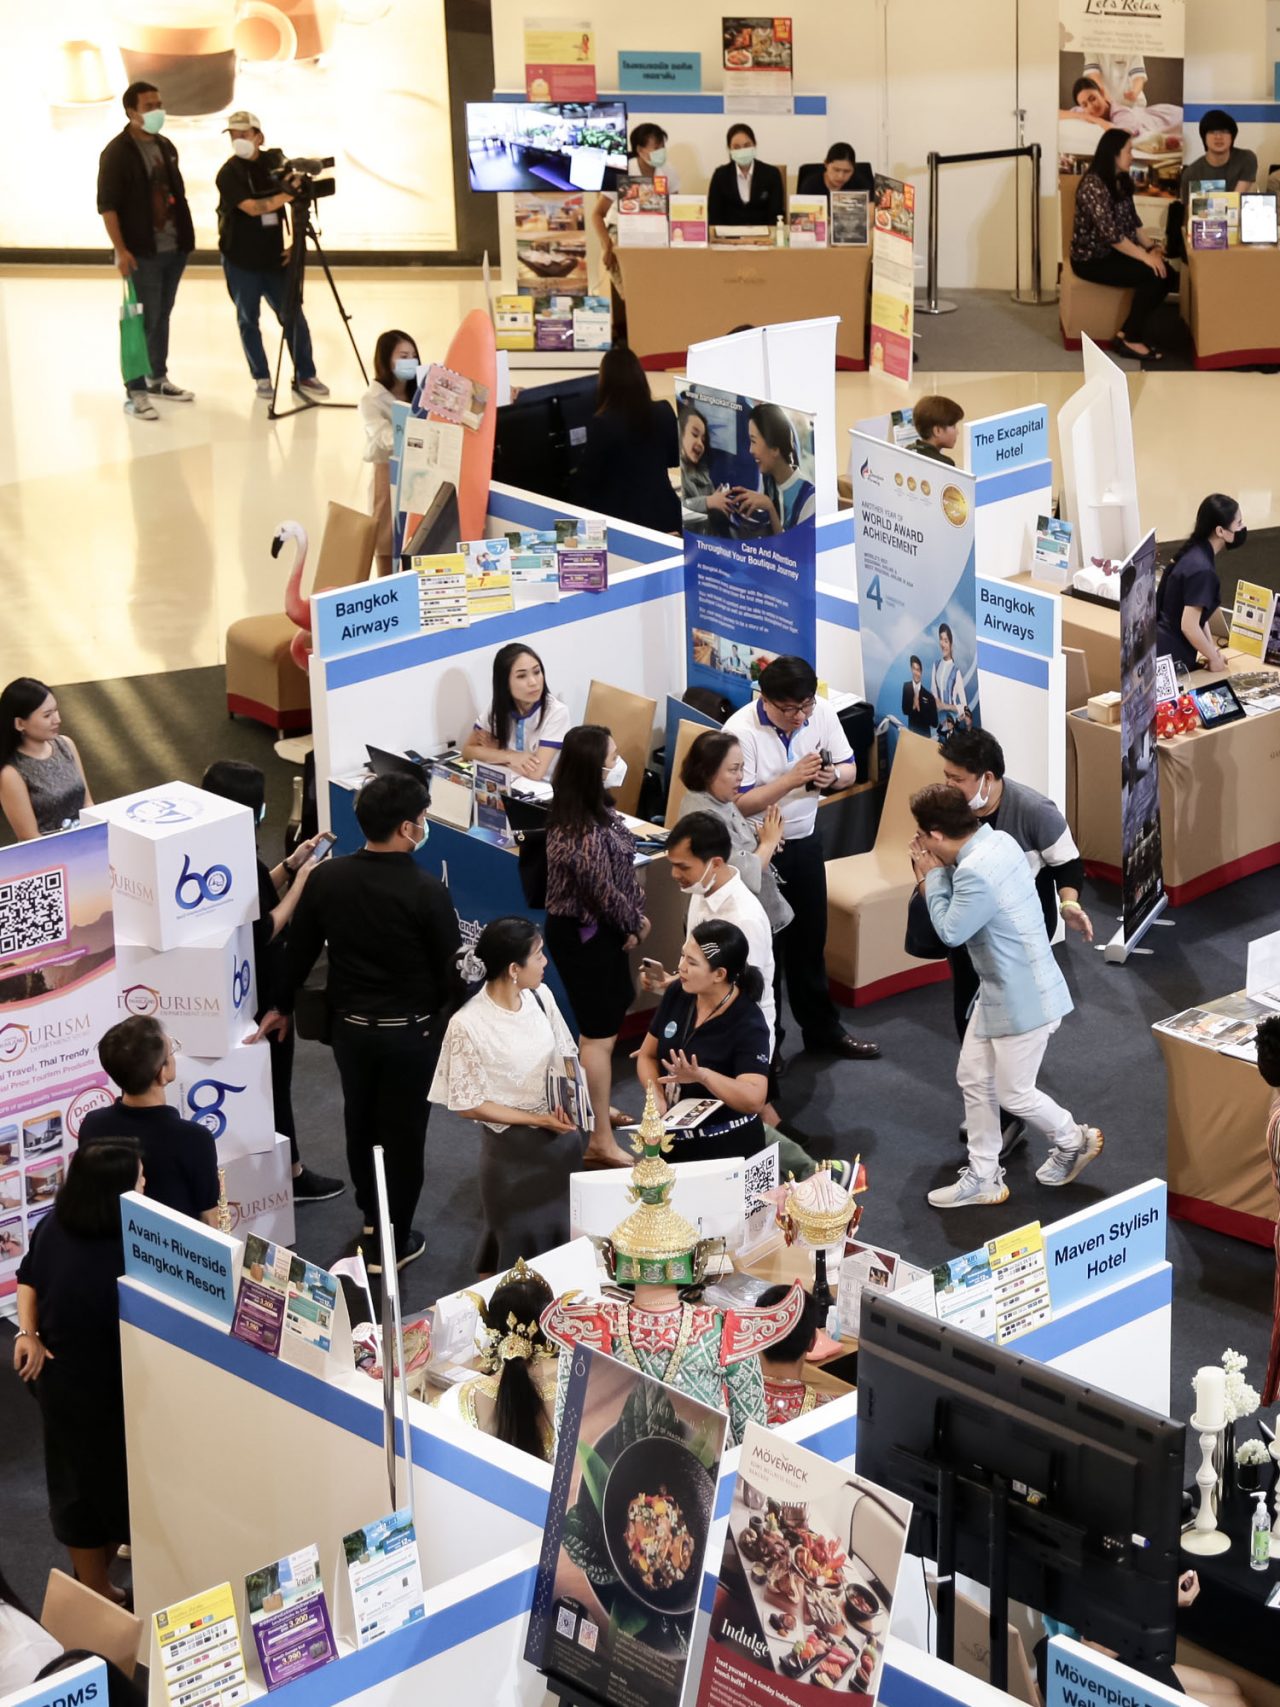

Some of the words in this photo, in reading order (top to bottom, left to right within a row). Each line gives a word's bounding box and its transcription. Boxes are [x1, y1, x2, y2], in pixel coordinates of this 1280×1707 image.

[975, 434, 994, 447] The
[997, 418, 1044, 441] Excapital
[996, 442, 1024, 461] Hotel
[862, 510, 892, 531] WORLD
[893, 523, 924, 543] AWARD
[863, 525, 918, 557] ACHIEVEMENT
[732, 551, 747, 564] Your
[748, 555, 776, 571] Boutique
[777, 566, 800, 581] Journey
[741, 543, 757, 555] Care
[758, 547, 771, 558] And
[772, 551, 797, 567] Attention
[335, 589, 399, 618] Bangkok
[866, 574, 883, 611] 4
[981, 588, 1036, 616] Bangkok
[341, 614, 400, 640] Airways
[984, 613, 1035, 640] Airways
[175, 854, 233, 910] 60
[7, 1063, 38, 1079] Travel,
[39, 1057, 57, 1068] Thai
[59, 1047, 89, 1062] Trendy
[73, 1093, 106, 1118] Don't
[1055, 1233, 1104, 1266] Maven
[1109, 1208, 1159, 1241] Stylish
[132, 1244, 184, 1281] Bangkok
[186, 1269, 226, 1300] Resort
[1087, 1247, 1126, 1279] Hotel
[752, 1445, 808, 1483] MÖVENPICK
[721, 1618, 770, 1657] Indulge
[41, 1682, 98, 1707] DMS
[757, 1680, 775, 1696] Sunday
[1055, 1659, 1140, 1707] Mövenpick
